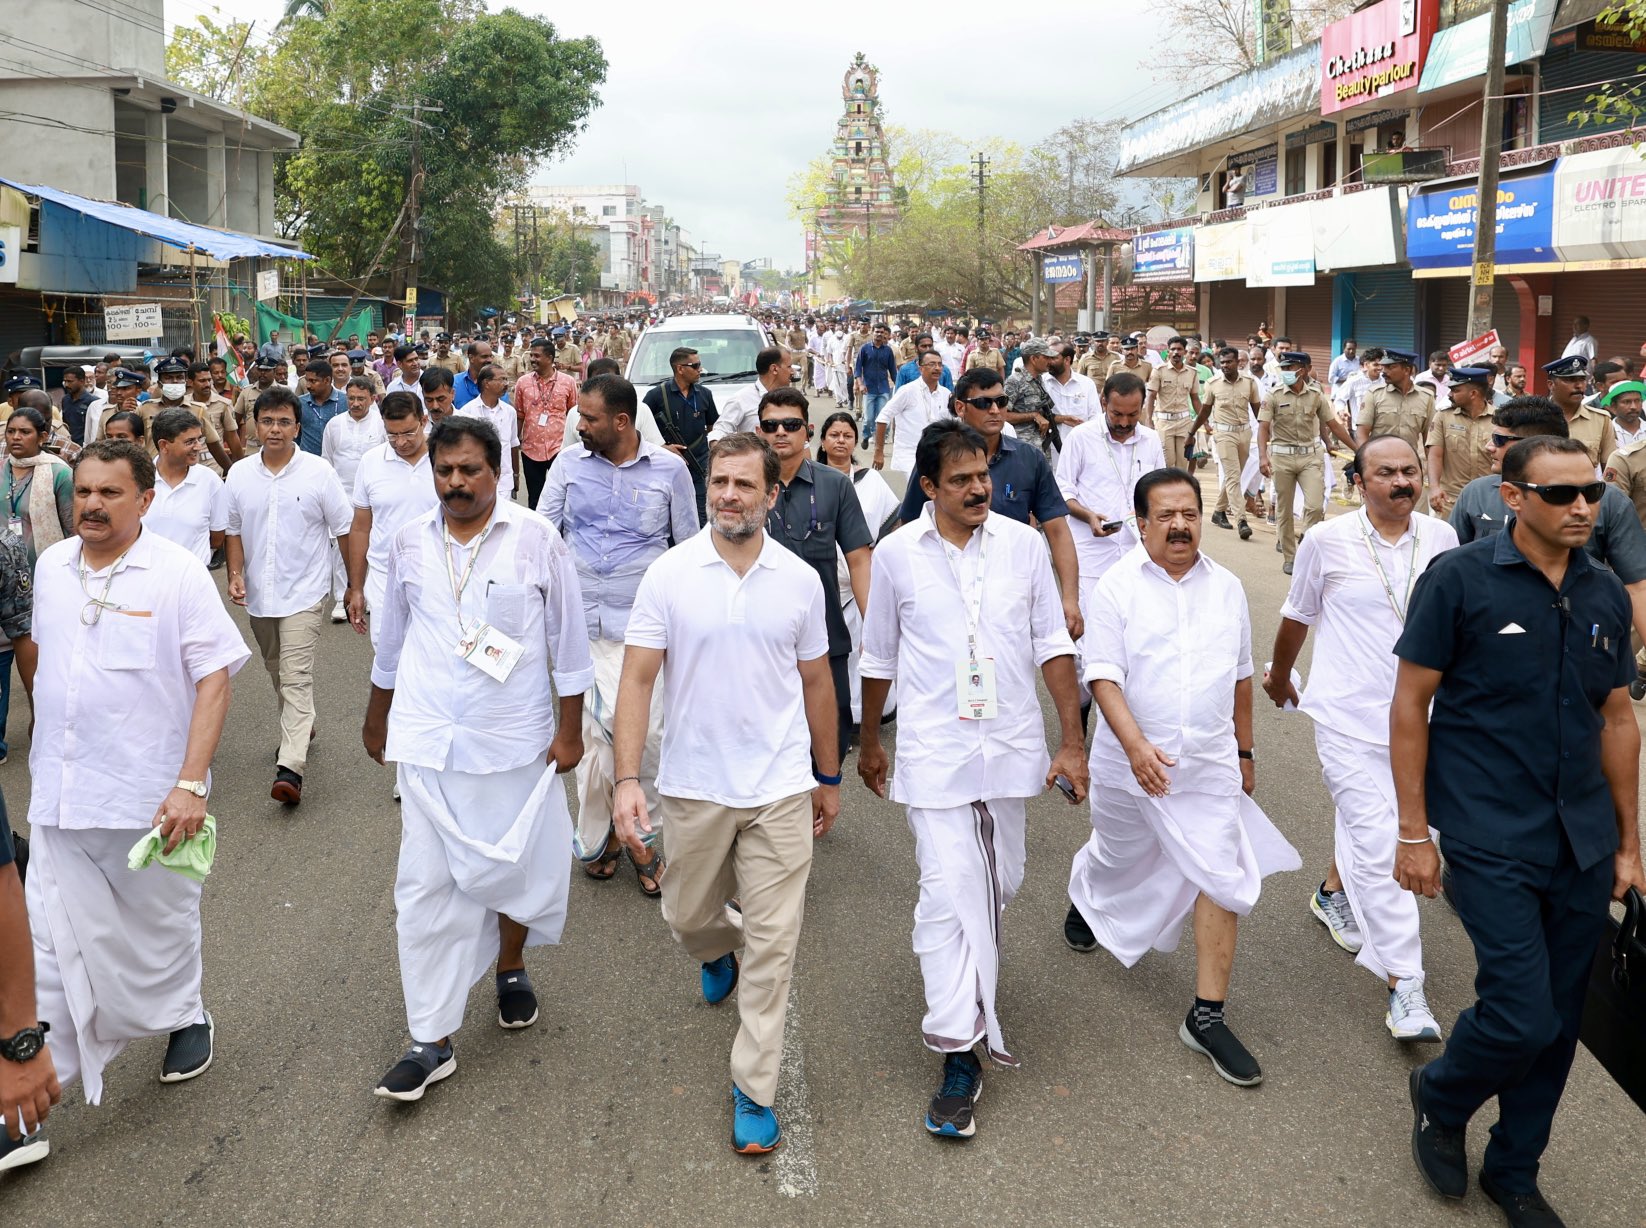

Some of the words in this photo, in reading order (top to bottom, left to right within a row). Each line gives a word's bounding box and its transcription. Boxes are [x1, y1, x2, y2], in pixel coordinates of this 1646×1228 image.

[1326, 41, 1395, 79] Chethana
[1335, 76, 1373, 102] Beauty
[1372, 61, 1416, 95] parlour
[1574, 201, 1616, 212] ELECTRO
[1458, 344, 1477, 358] airtel
